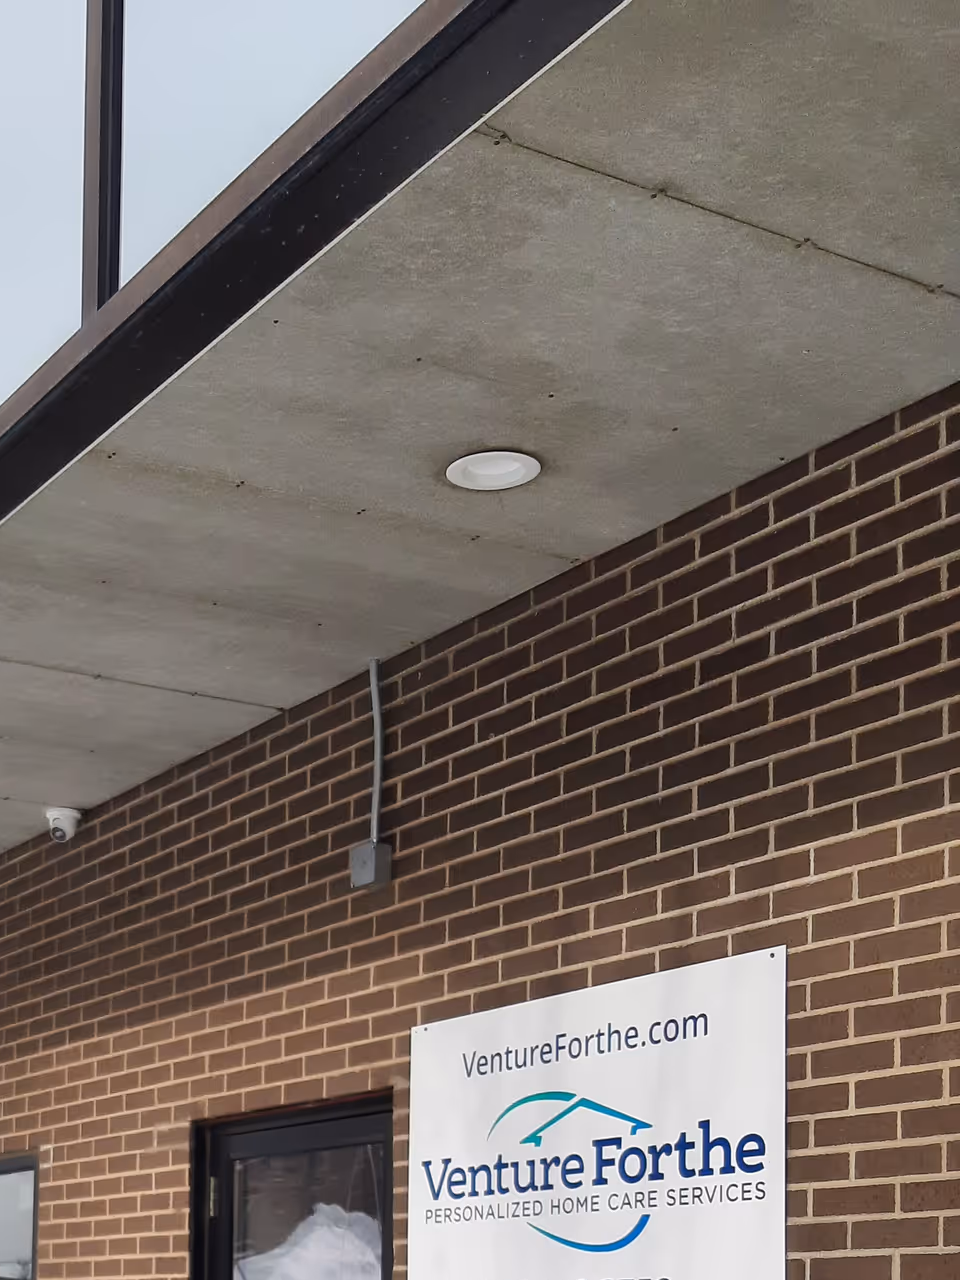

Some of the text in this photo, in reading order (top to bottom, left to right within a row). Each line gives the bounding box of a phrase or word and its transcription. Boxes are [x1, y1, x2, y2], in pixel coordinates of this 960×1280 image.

[462, 1012, 708, 1078] VentureForthe.com
[422, 1119, 766, 1201] Venture Forthe
[425, 1181, 767, 1225] PERSONALIZED HOME CARE SERVICES
